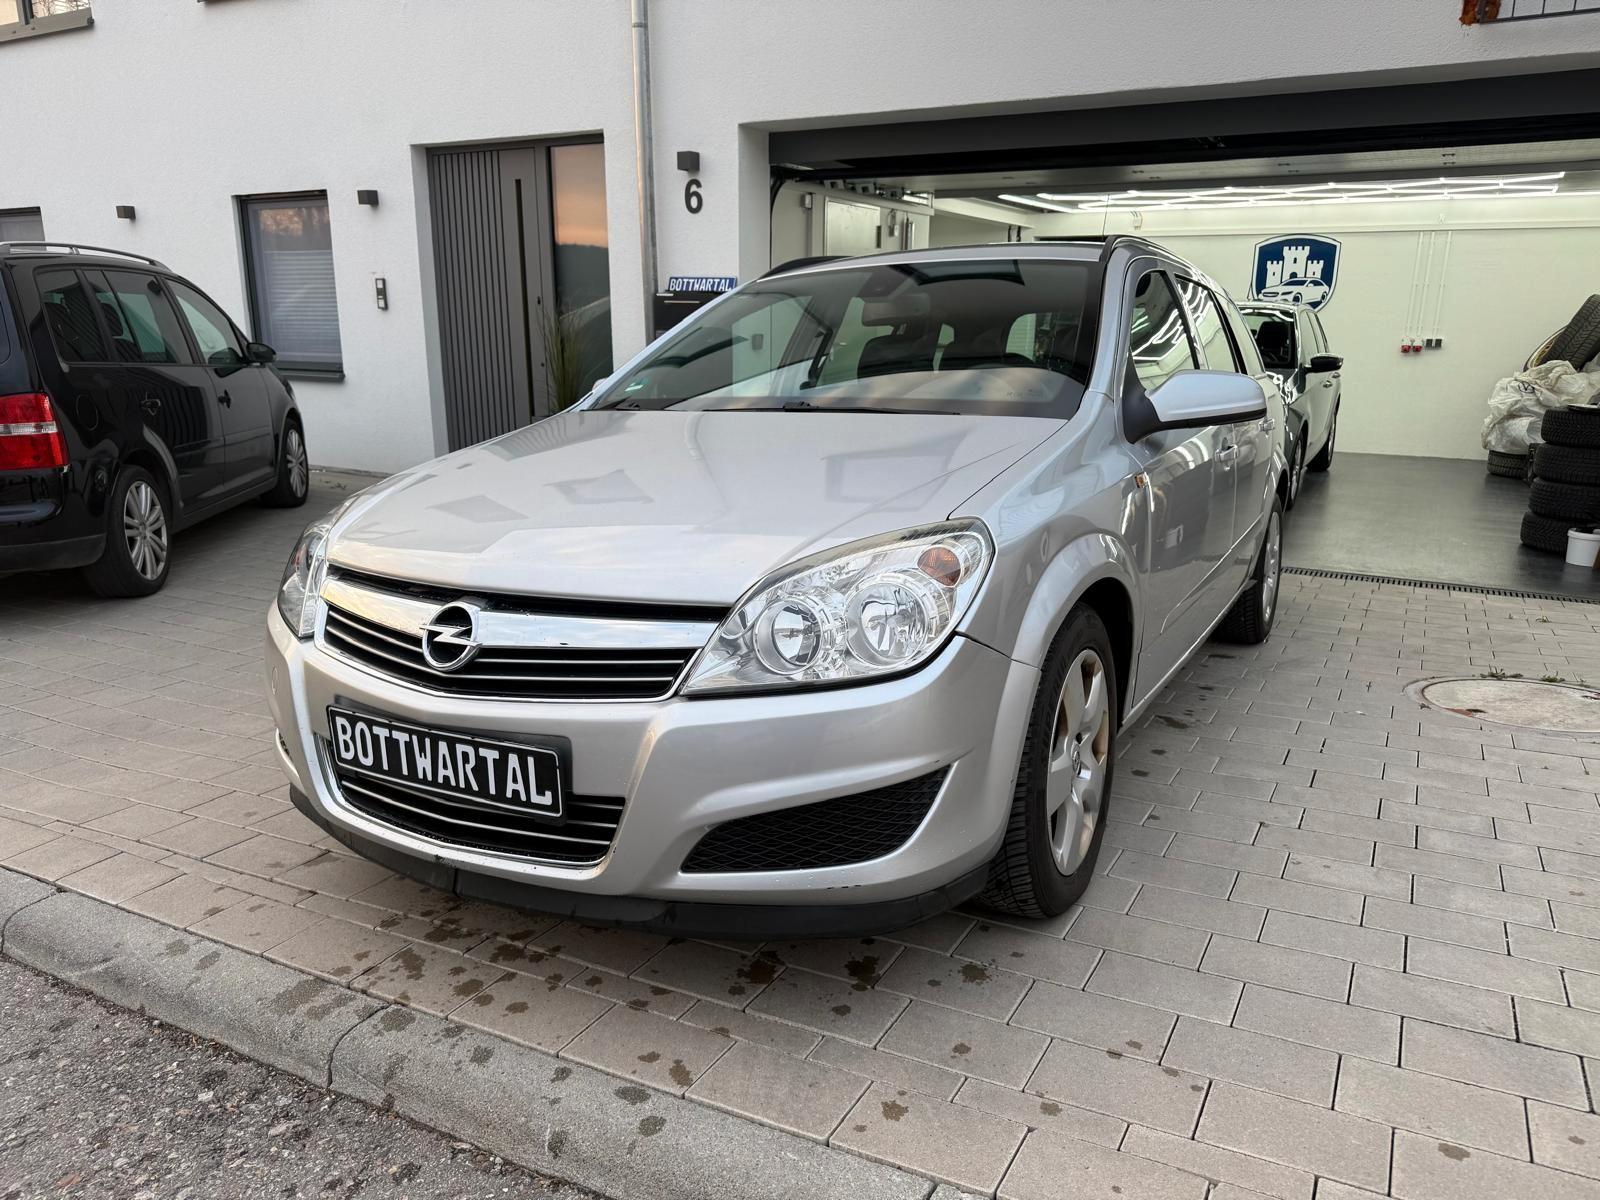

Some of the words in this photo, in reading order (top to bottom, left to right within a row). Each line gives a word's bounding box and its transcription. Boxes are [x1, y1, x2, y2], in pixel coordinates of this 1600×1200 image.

[684, 178, 704, 215] 6
[669, 278, 732, 292] BOTTWARTAL
[335, 716, 552, 805] BOTTWARTAL
